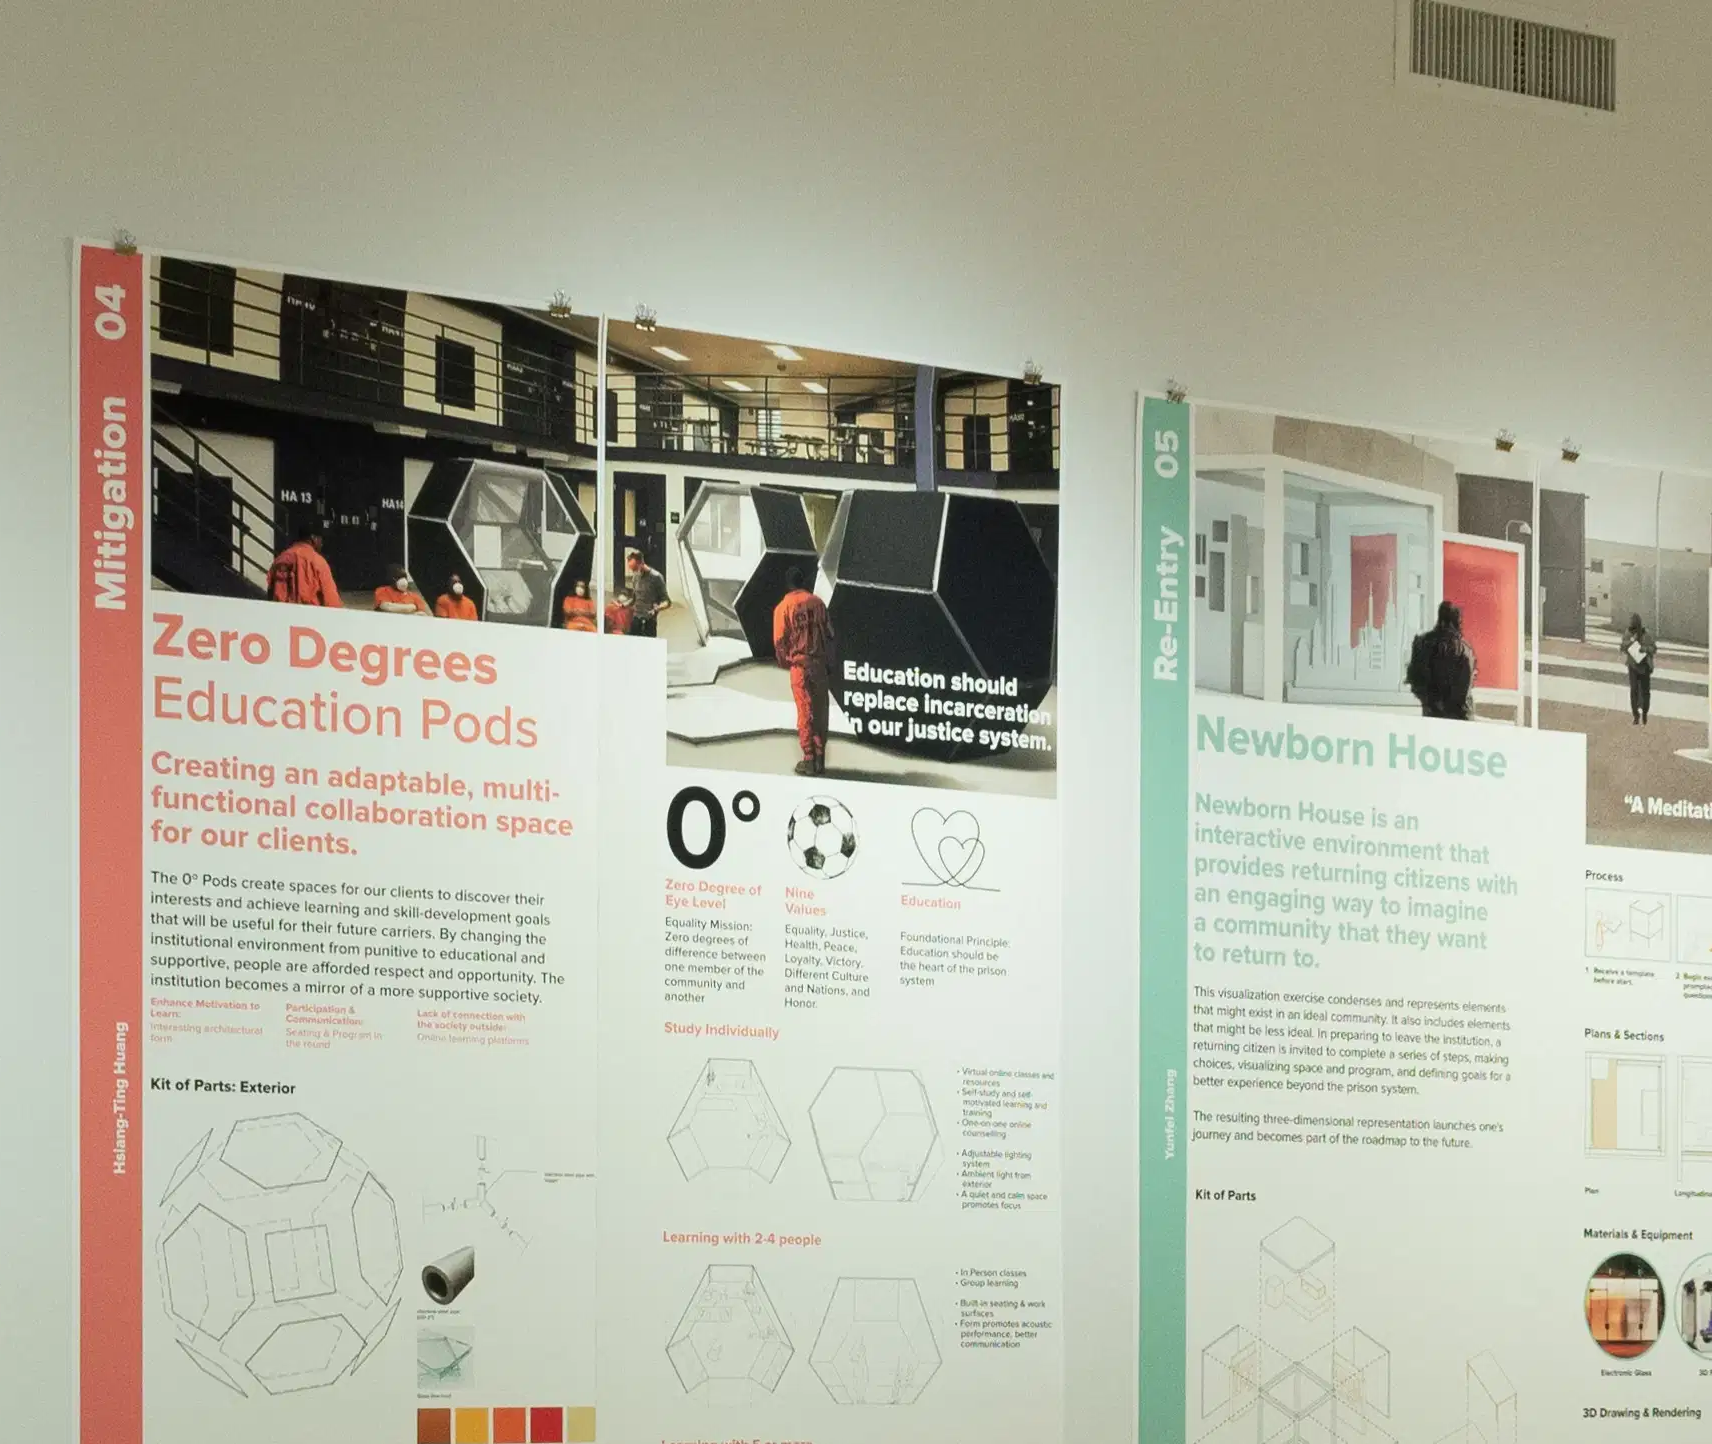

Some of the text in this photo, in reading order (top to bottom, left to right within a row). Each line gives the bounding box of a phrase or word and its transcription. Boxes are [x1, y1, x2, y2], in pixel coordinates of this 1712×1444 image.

[94, 284, 135, 611] Mitigation 04
[1153, 429, 1185, 683] Re-Entry 05
[152, 611, 497, 686] Zero Degrees
[843, 659, 1018, 697] Education should
[154, 675, 537, 747] Education Pods
[843, 688, 1053, 725] replace incarceration
[867, 718, 903, 736] our
[905, 717, 975, 743] justice
[979, 726, 1053, 753] system.
[1196, 713, 1509, 777] Newborn House
[151, 750, 559, 801] Creating an adaptable, multi-
[150, 784, 572, 837] functional collaboration space
[1624, 795, 1644, 815] “A
[150, 818, 357, 855] for our clients.
[664, 1021, 779, 1041] Study Individually
[113, 1021, 129, 1175] Hsiang-Ting Huang
[150, 1077, 296, 1094] Kit of Parts: Exterior
[1195, 1188, 1256, 1201] Kit of Parts
[1583, 1227, 1693, 1242] Materials & Equipment
[1582, 1406, 1702, 1420] 3D Drawing & Rendering
